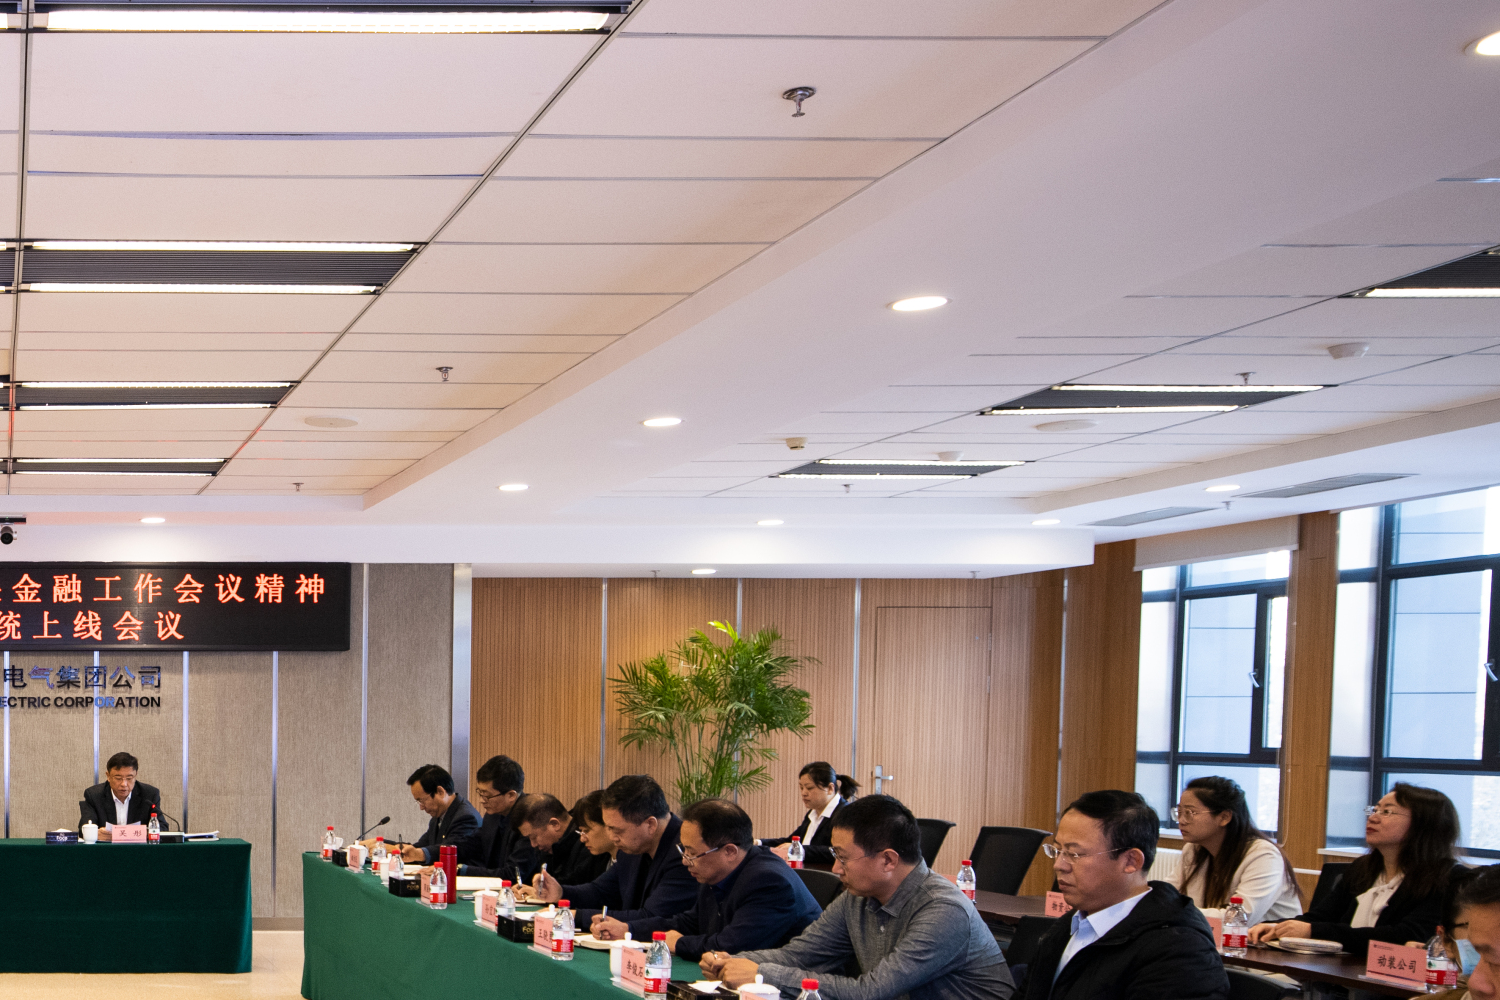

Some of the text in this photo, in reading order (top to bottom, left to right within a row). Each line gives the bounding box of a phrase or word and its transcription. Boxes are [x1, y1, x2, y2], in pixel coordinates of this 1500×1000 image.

[54, 696, 161, 708] CORPORATION
[1377, 954, 1417, 974] 动装公司
